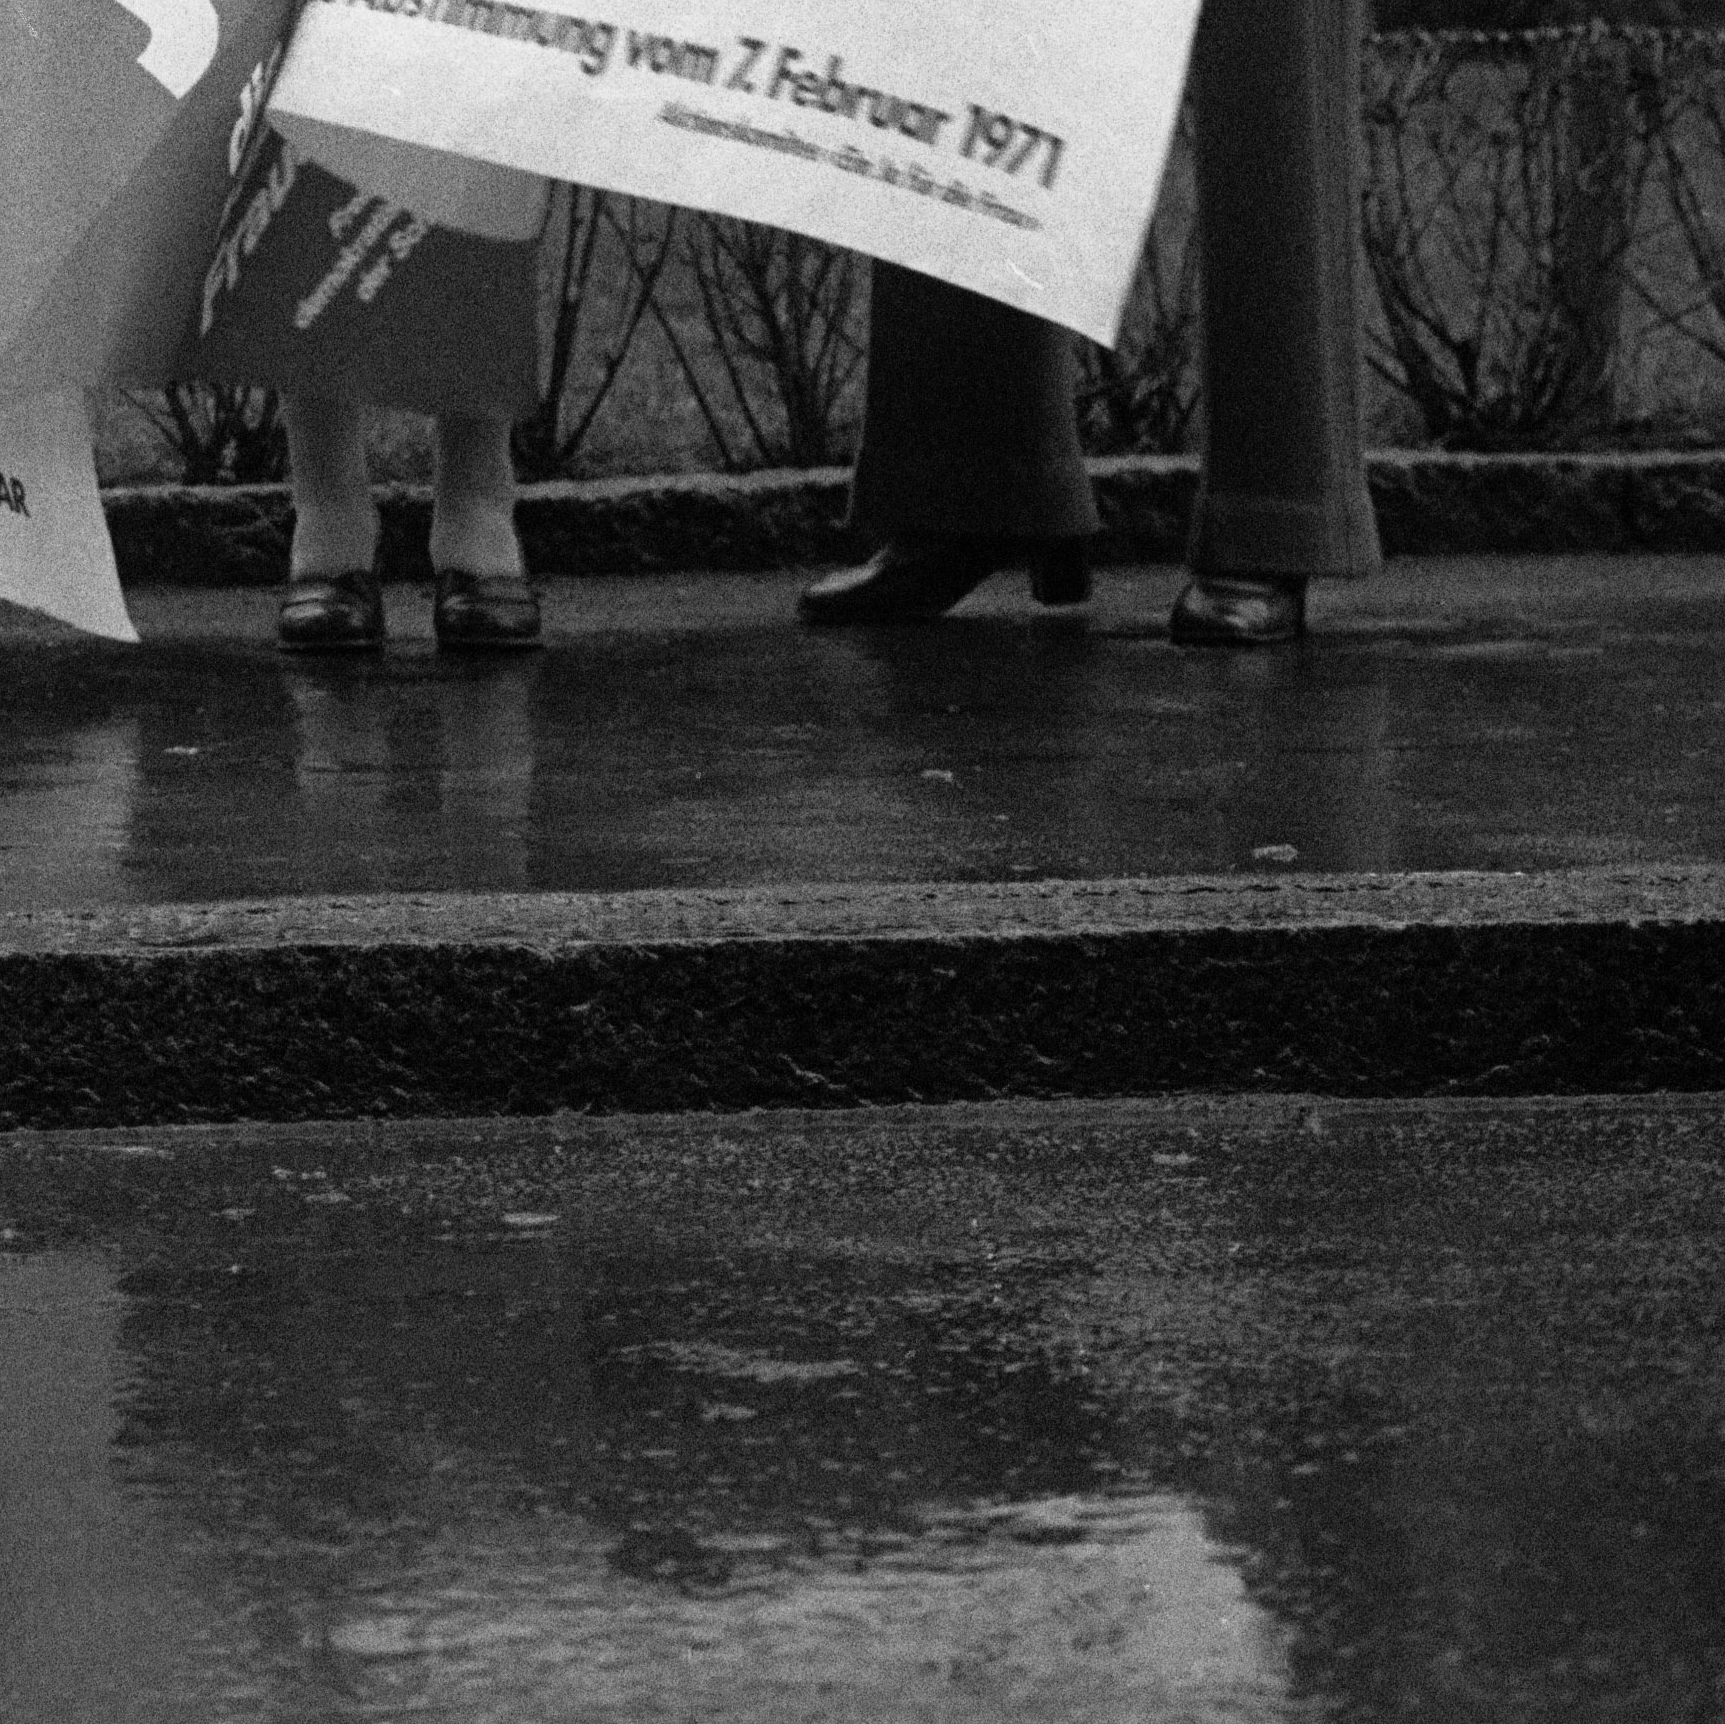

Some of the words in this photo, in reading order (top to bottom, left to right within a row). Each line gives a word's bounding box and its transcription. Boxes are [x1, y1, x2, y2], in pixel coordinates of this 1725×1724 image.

[625, 29, 719, 86] vom
[766, 45, 952, 147] Februar
[959, 102, 1067, 190] 1971
